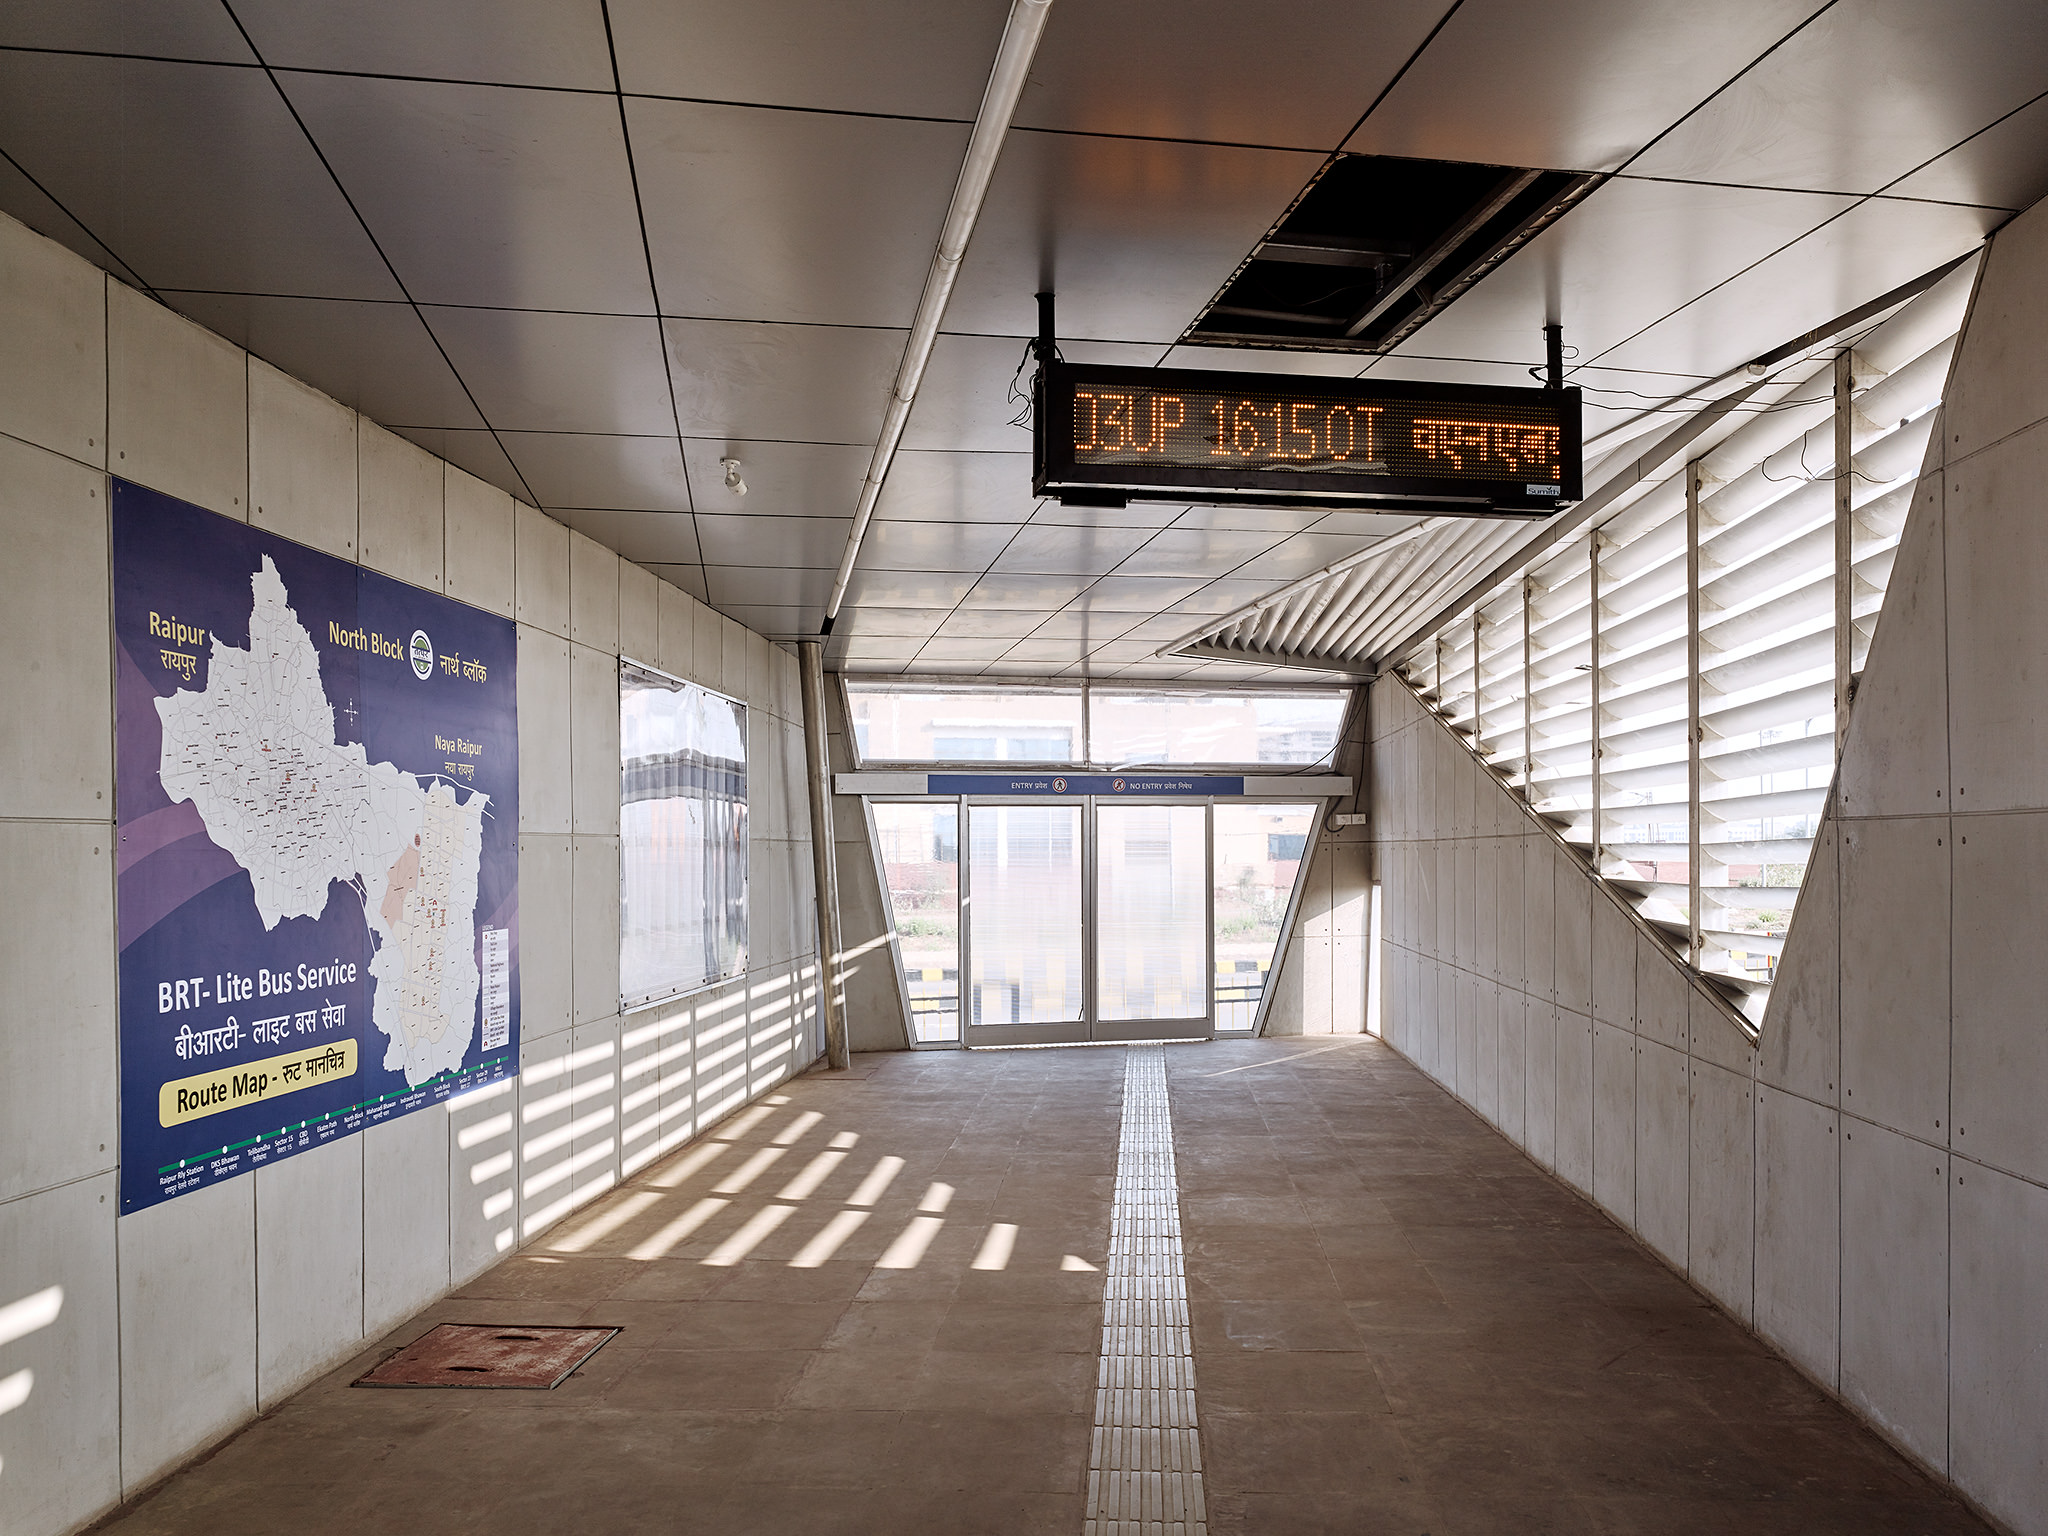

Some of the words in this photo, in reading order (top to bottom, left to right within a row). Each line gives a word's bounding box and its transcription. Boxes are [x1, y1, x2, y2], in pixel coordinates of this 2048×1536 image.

[149, 610, 206, 648] Raipur
[329, 620, 368, 652] North
[371, 632, 405, 662] Block
[160, 649, 197, 681] रायपुर
[462, 658, 487, 684] ब्लॉक
[434, 734, 456, 755] Naya
[457, 737, 483, 758] Raipur
[444, 761, 457, 775] नया
[457, 762, 475, 782] रायपुर
[1129, 782, 1140, 790] NO
[1141, 782, 1163, 790] ENTRY
[158, 976, 211, 1014] BRT-
[216, 972, 253, 1004] Lite
[258, 968, 293, 998] Bus
[297, 957, 357, 991] Service
[252, 1014, 291, 1045] लाइट
[295, 1009, 318, 1034] बस
[321, 998, 347, 1030] सेवा
[177, 1082, 227, 1114] Route
[232, 1072, 268, 1098] Map
[305, 1047, 346, 1077] मानचित्र
[274, 1137, 288, 1148] Sector
[210, 1159, 221, 1170] DKS
[221, 1154, 240, 1166] Bhawan
[159, 1173, 177, 1186] Raipur
[186, 1165, 204, 1177] Station
